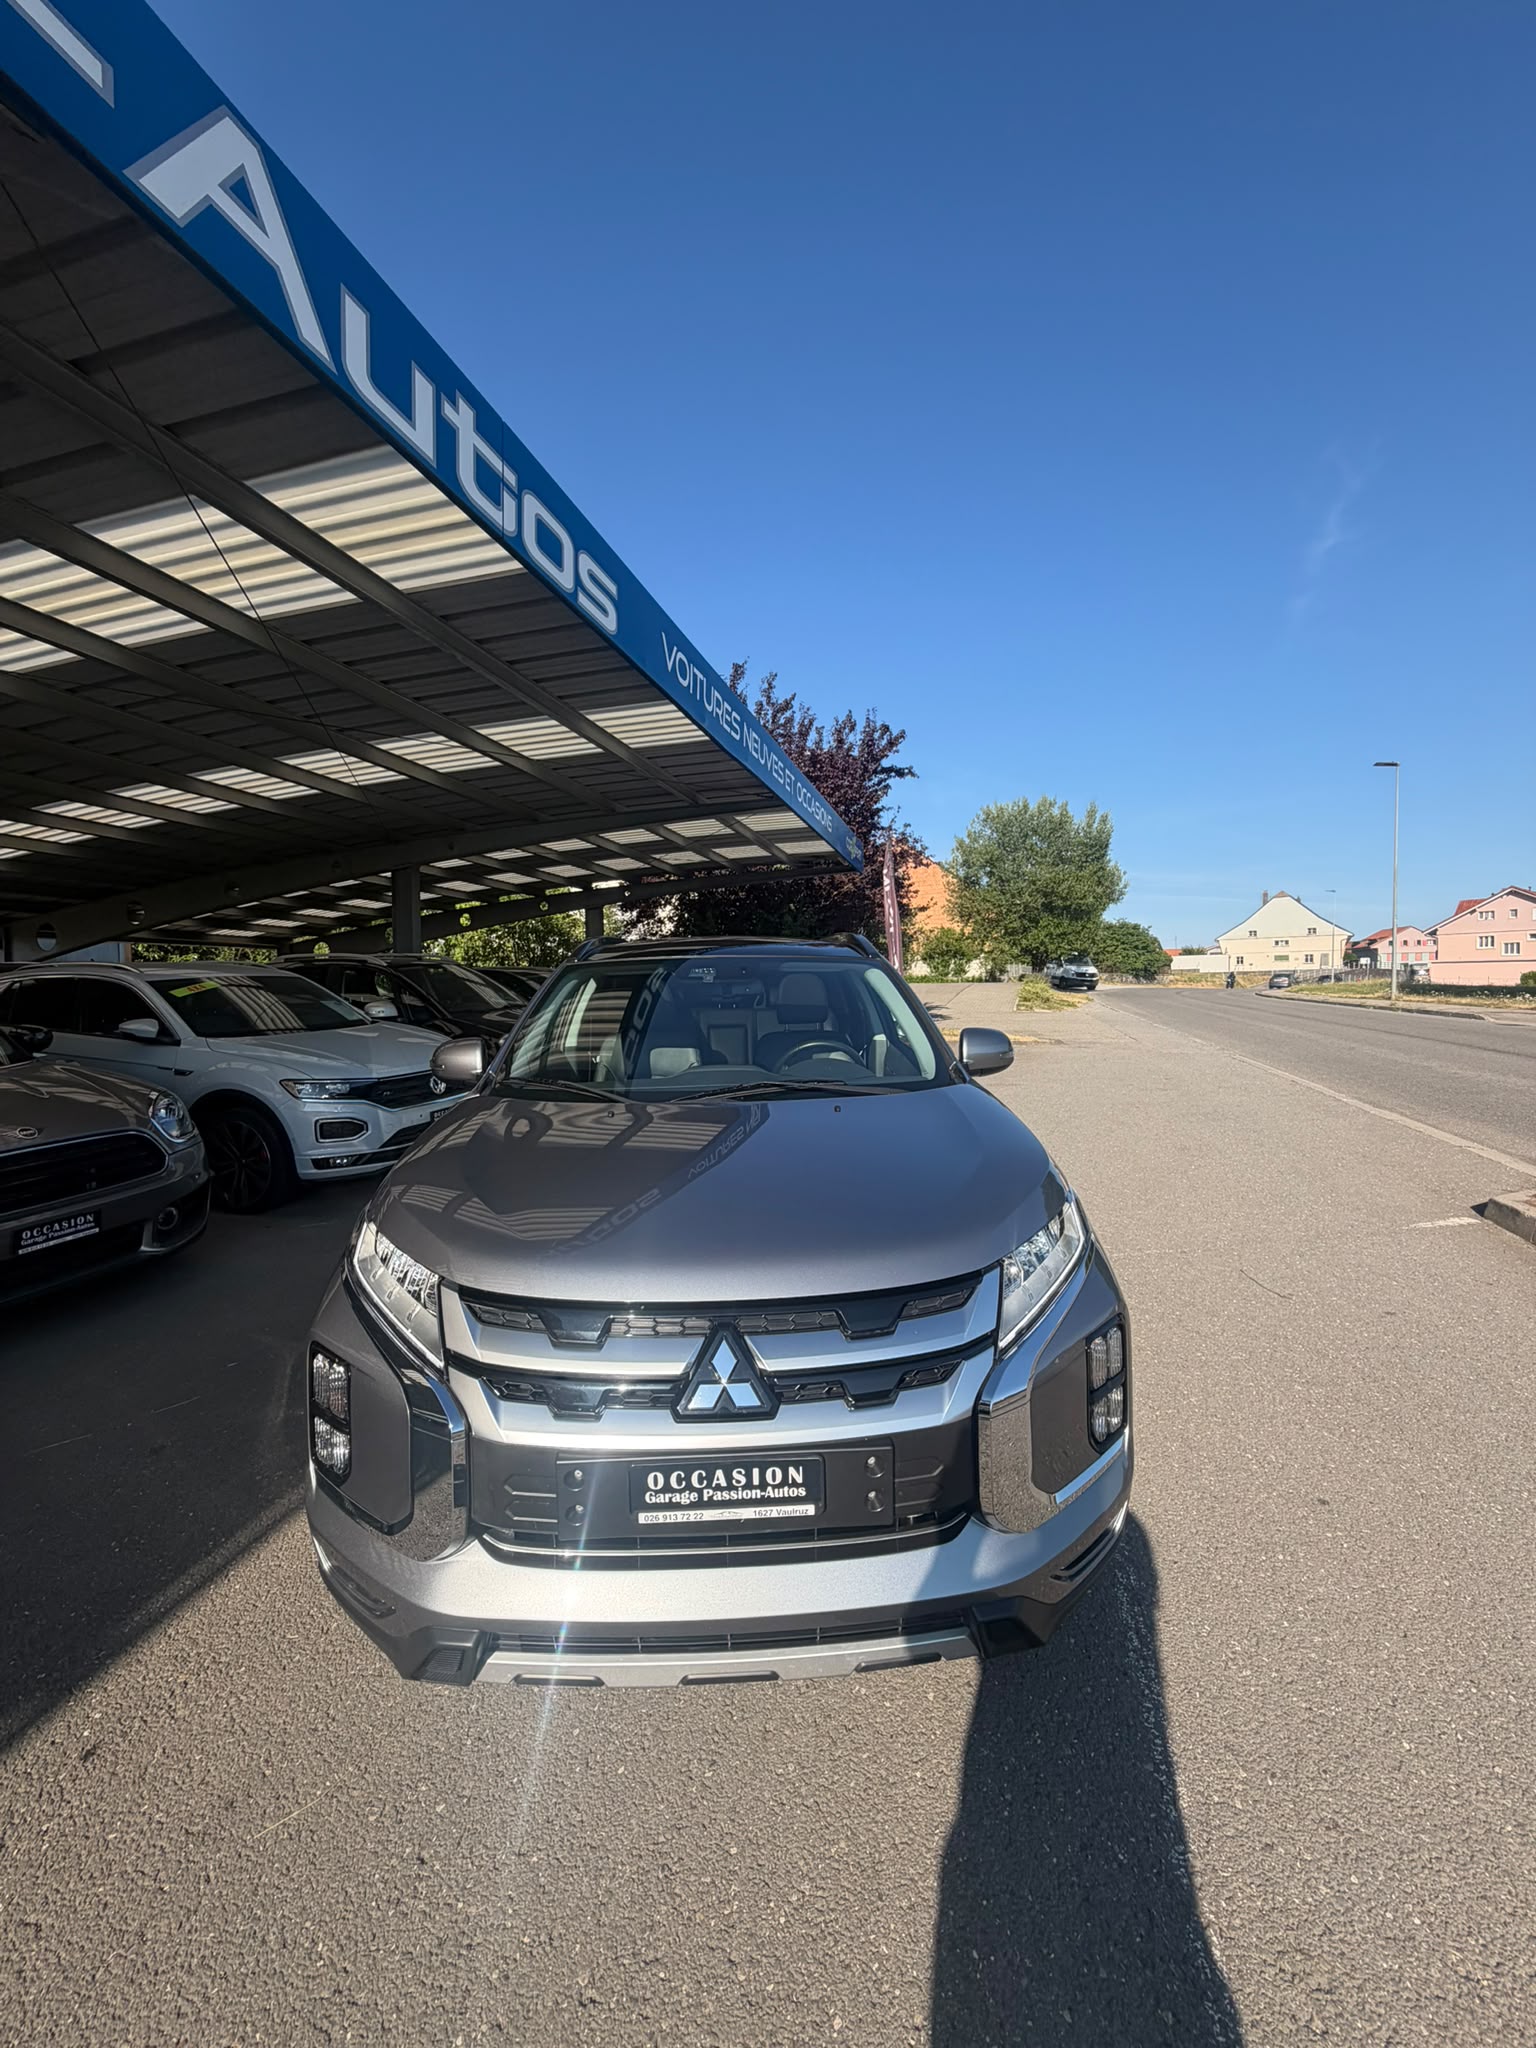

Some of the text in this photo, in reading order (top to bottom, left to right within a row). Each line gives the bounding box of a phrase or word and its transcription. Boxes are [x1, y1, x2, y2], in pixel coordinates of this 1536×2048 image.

[661, 631, 832, 833] VOITURES NEUVES ET OCCASIONS
[22, 1213, 94, 1240] OCCASION
[647, 1466, 803, 1490] OCCASION
[644, 1485, 806, 1505] Garage Passion-Autos
[643, 1507, 809, 1522] 026 913 72 22 1627 Vaulruz
